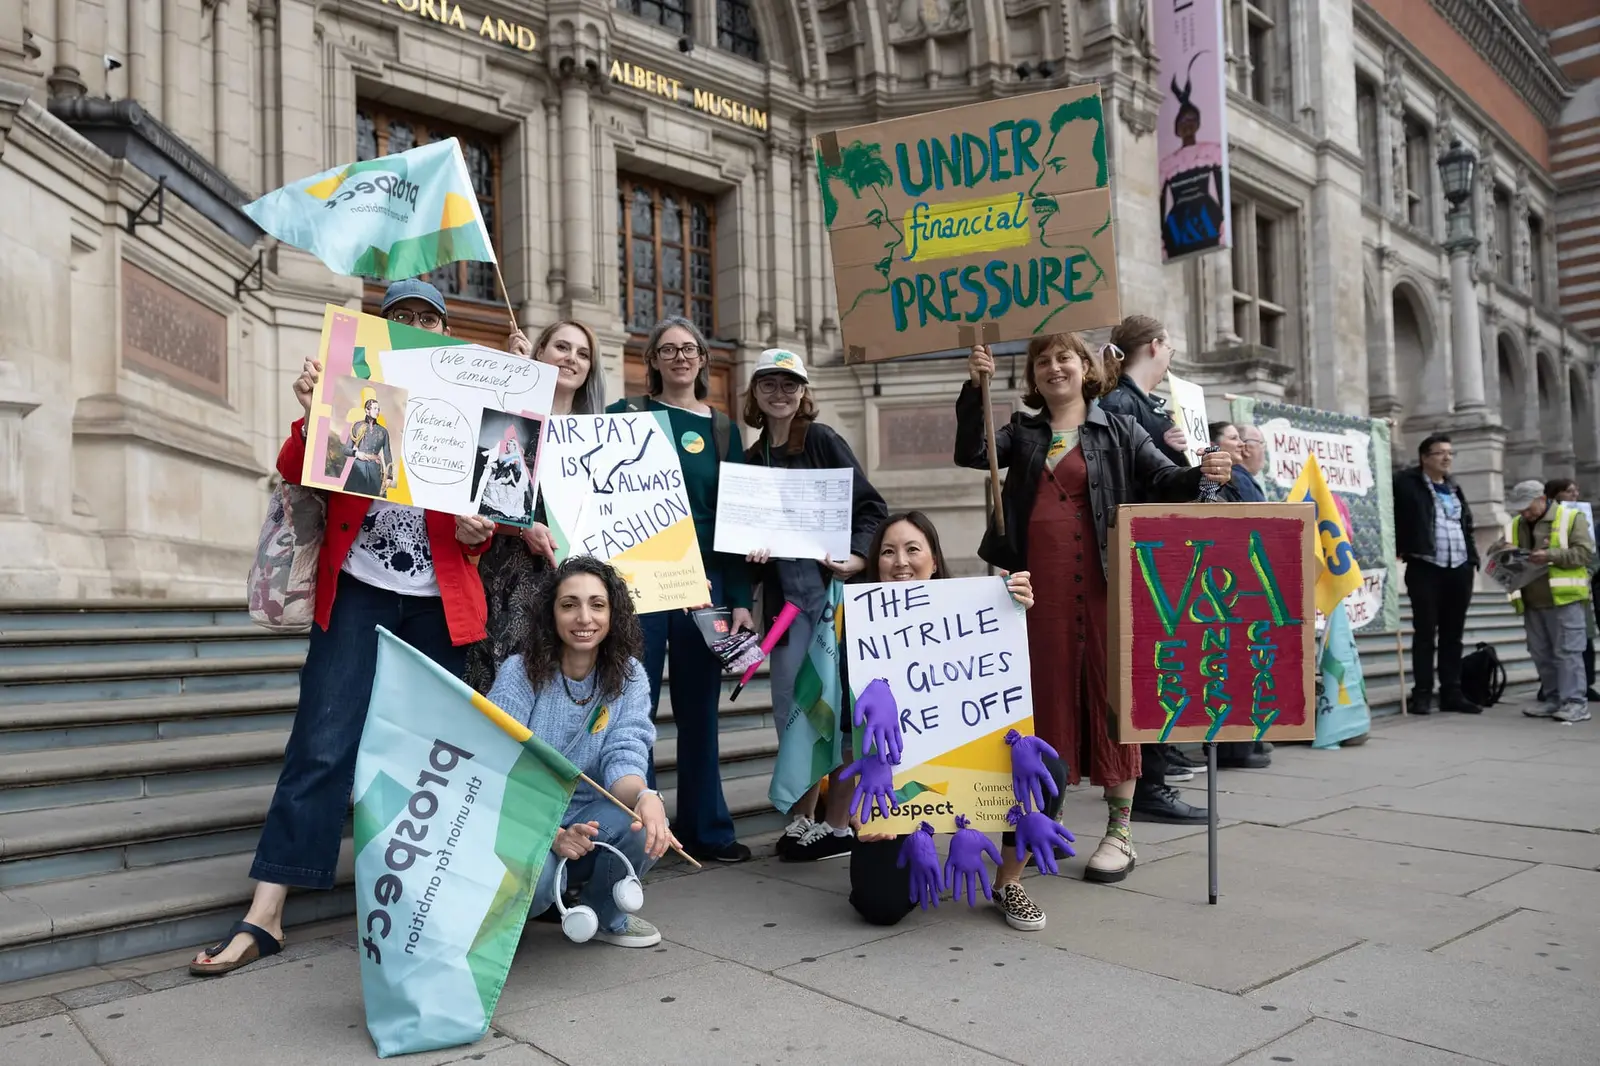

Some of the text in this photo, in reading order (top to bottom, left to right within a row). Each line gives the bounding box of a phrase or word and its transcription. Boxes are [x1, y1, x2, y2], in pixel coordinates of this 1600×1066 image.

[380, 0, 537, 51] ORIA AND
[609, 59, 768, 131] ALBERT MUSEUM
[895, 118, 1042, 197] UNDER
[901, 192, 1028, 262] financial
[891, 253, 1094, 333] PRESSURE
[440, 350, 531, 377] We are not
[456, 370, 512, 388] amused
[415, 408, 460, 429] Victoria!
[547, 417, 638, 445] AIR PAY
[409, 428, 467, 449] The workers
[420, 443, 438, 452] are
[1274, 433, 1301, 454] MAY
[1327, 442, 1354, 463] LIVE
[410, 451, 466, 470] REVOLTING
[561, 456, 577, 477] IS
[618, 469, 681, 493] ALWAYS
[1319, 465, 1348, 487] ORK
[1350, 469, 1361, 488] IN
[599, 502, 613, 516] IN
[583, 493, 689, 559] FASHION
[1130, 530, 1304, 637] V&A
[854, 585, 930, 622] THE
[858, 607, 999, 660] NITRILE
[907, 651, 1012, 693] GLOVES
[900, 686, 1022, 735] RE OFF
[973, 782, 1014, 792] Connect
[871, 801, 954, 822] pospect
